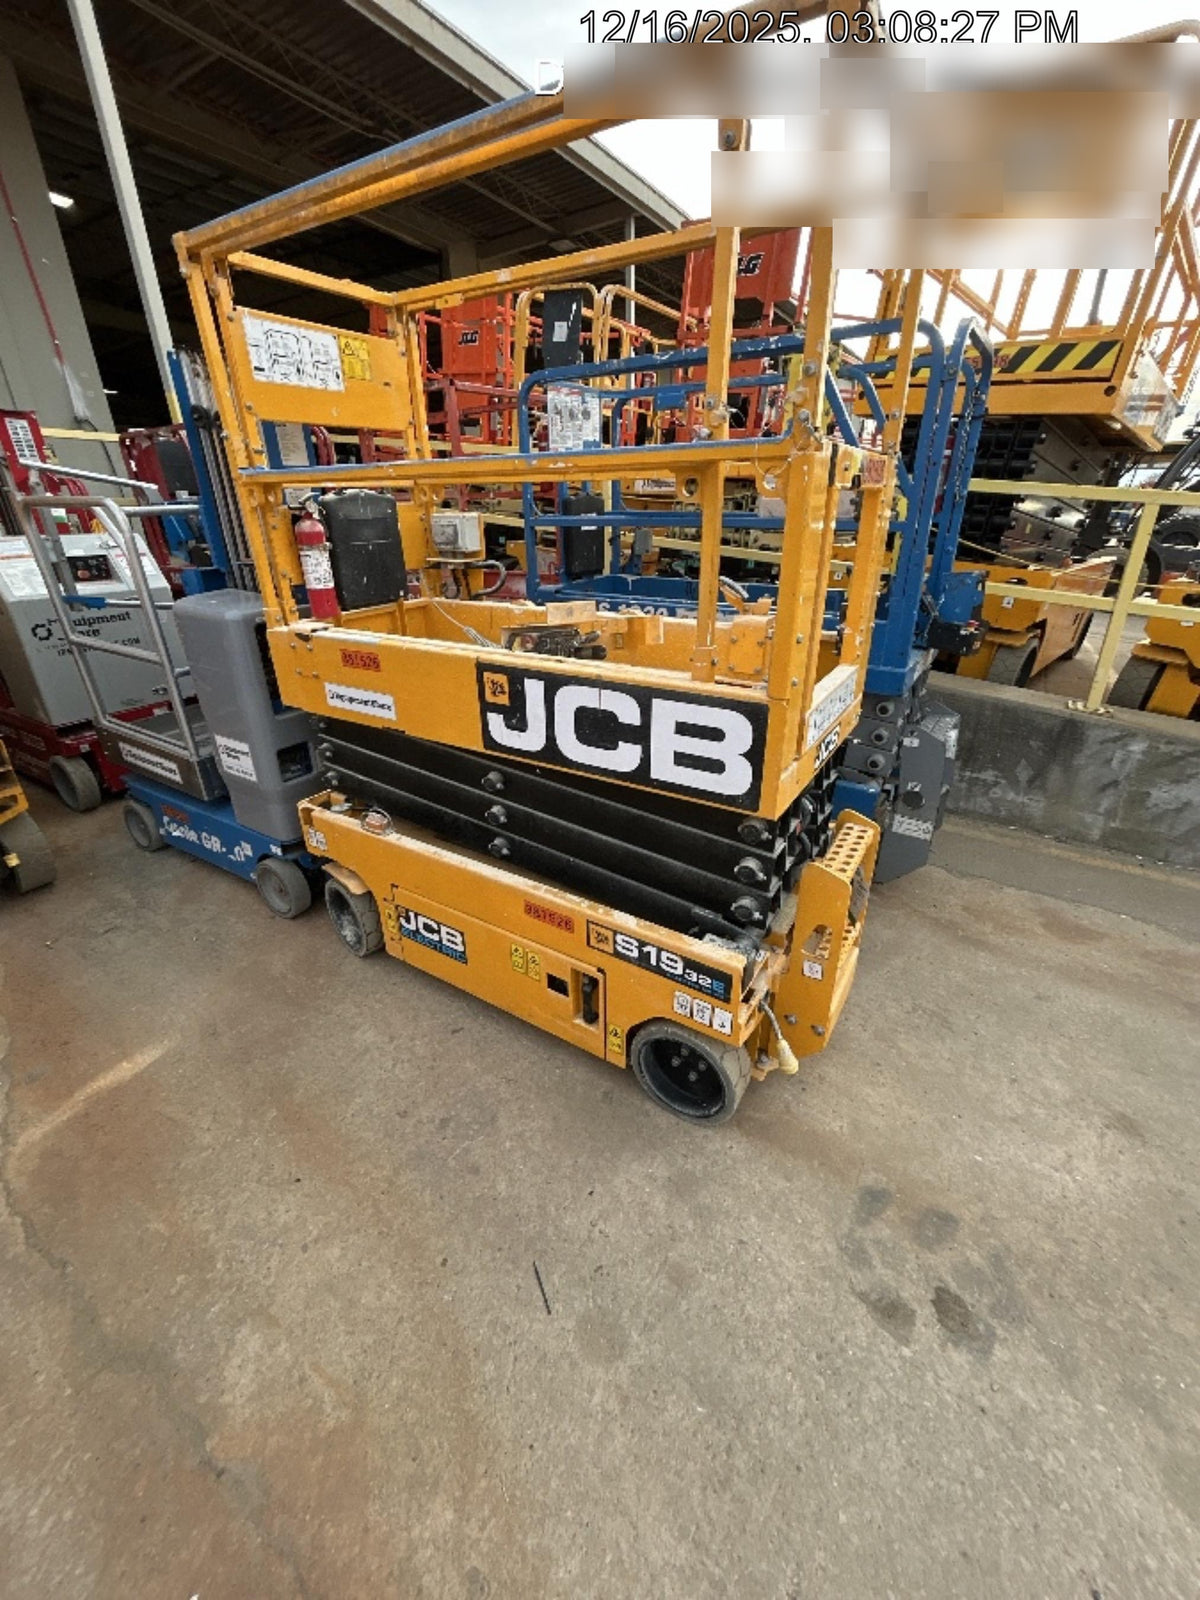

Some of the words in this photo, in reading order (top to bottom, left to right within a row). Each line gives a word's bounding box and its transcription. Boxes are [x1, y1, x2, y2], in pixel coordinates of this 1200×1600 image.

[738, 252, 765, 276] LG
[487, 678, 753, 796] JCB
[399, 911, 465, 952] JCB
